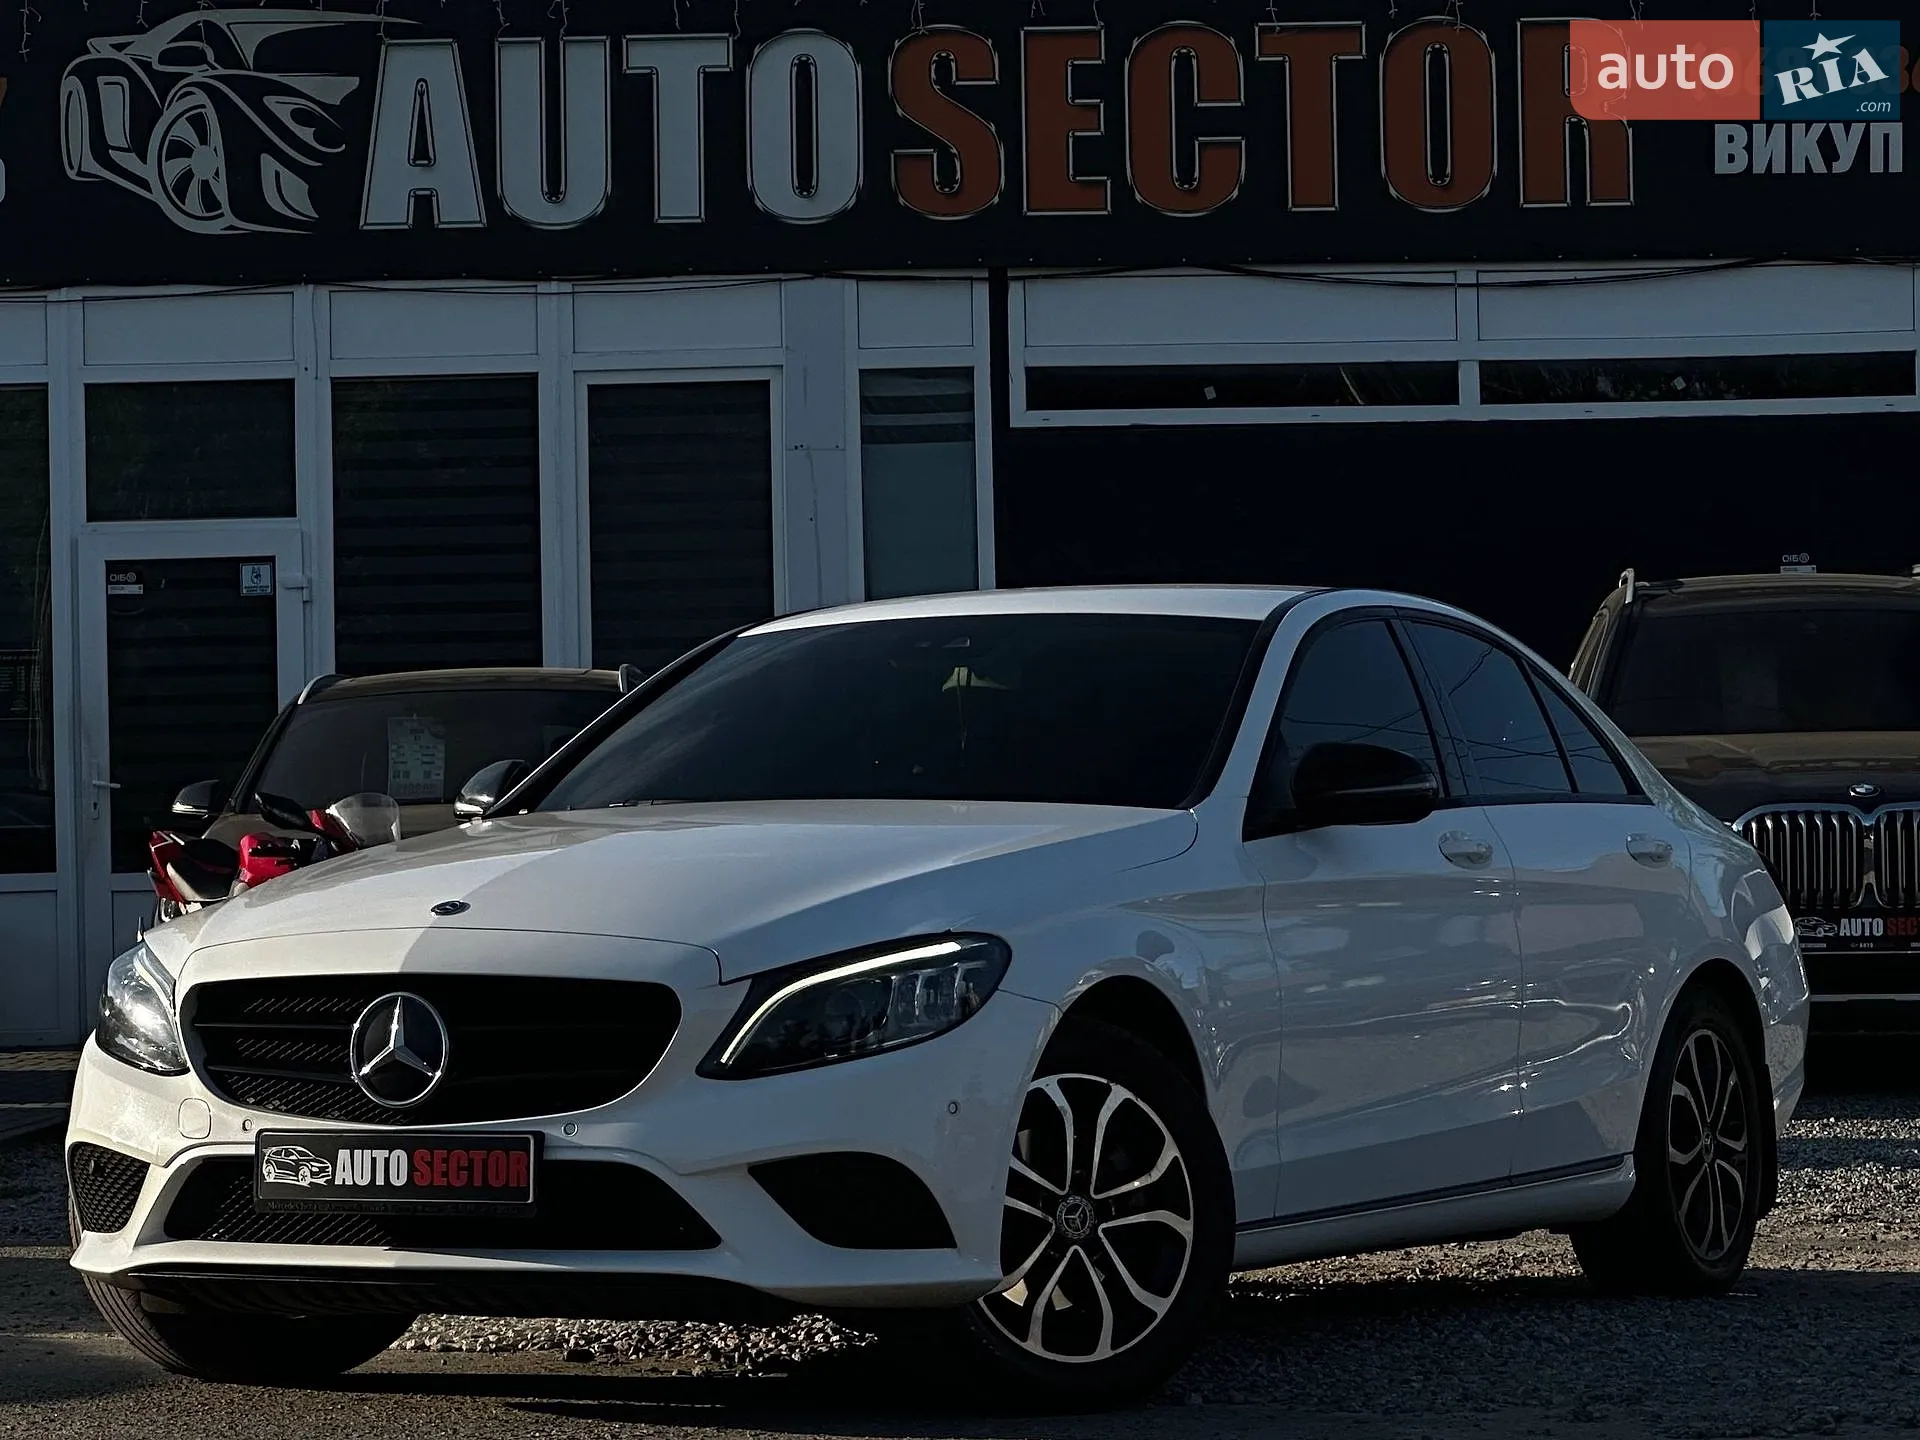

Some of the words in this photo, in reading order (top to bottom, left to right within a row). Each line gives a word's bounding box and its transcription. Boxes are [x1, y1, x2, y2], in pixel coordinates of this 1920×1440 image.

[361, 28, 863, 230] AUTO
[889, 16, 1634, 220] SECTOR
[1714, 122, 1903, 174] ВИКУП
[1839, 918, 1884, 937] AUTO
[1886, 917, 1920, 937] SEC
[334, 1148, 408, 1186] AUTO
[412, 1149, 529, 1188] SECTOR
